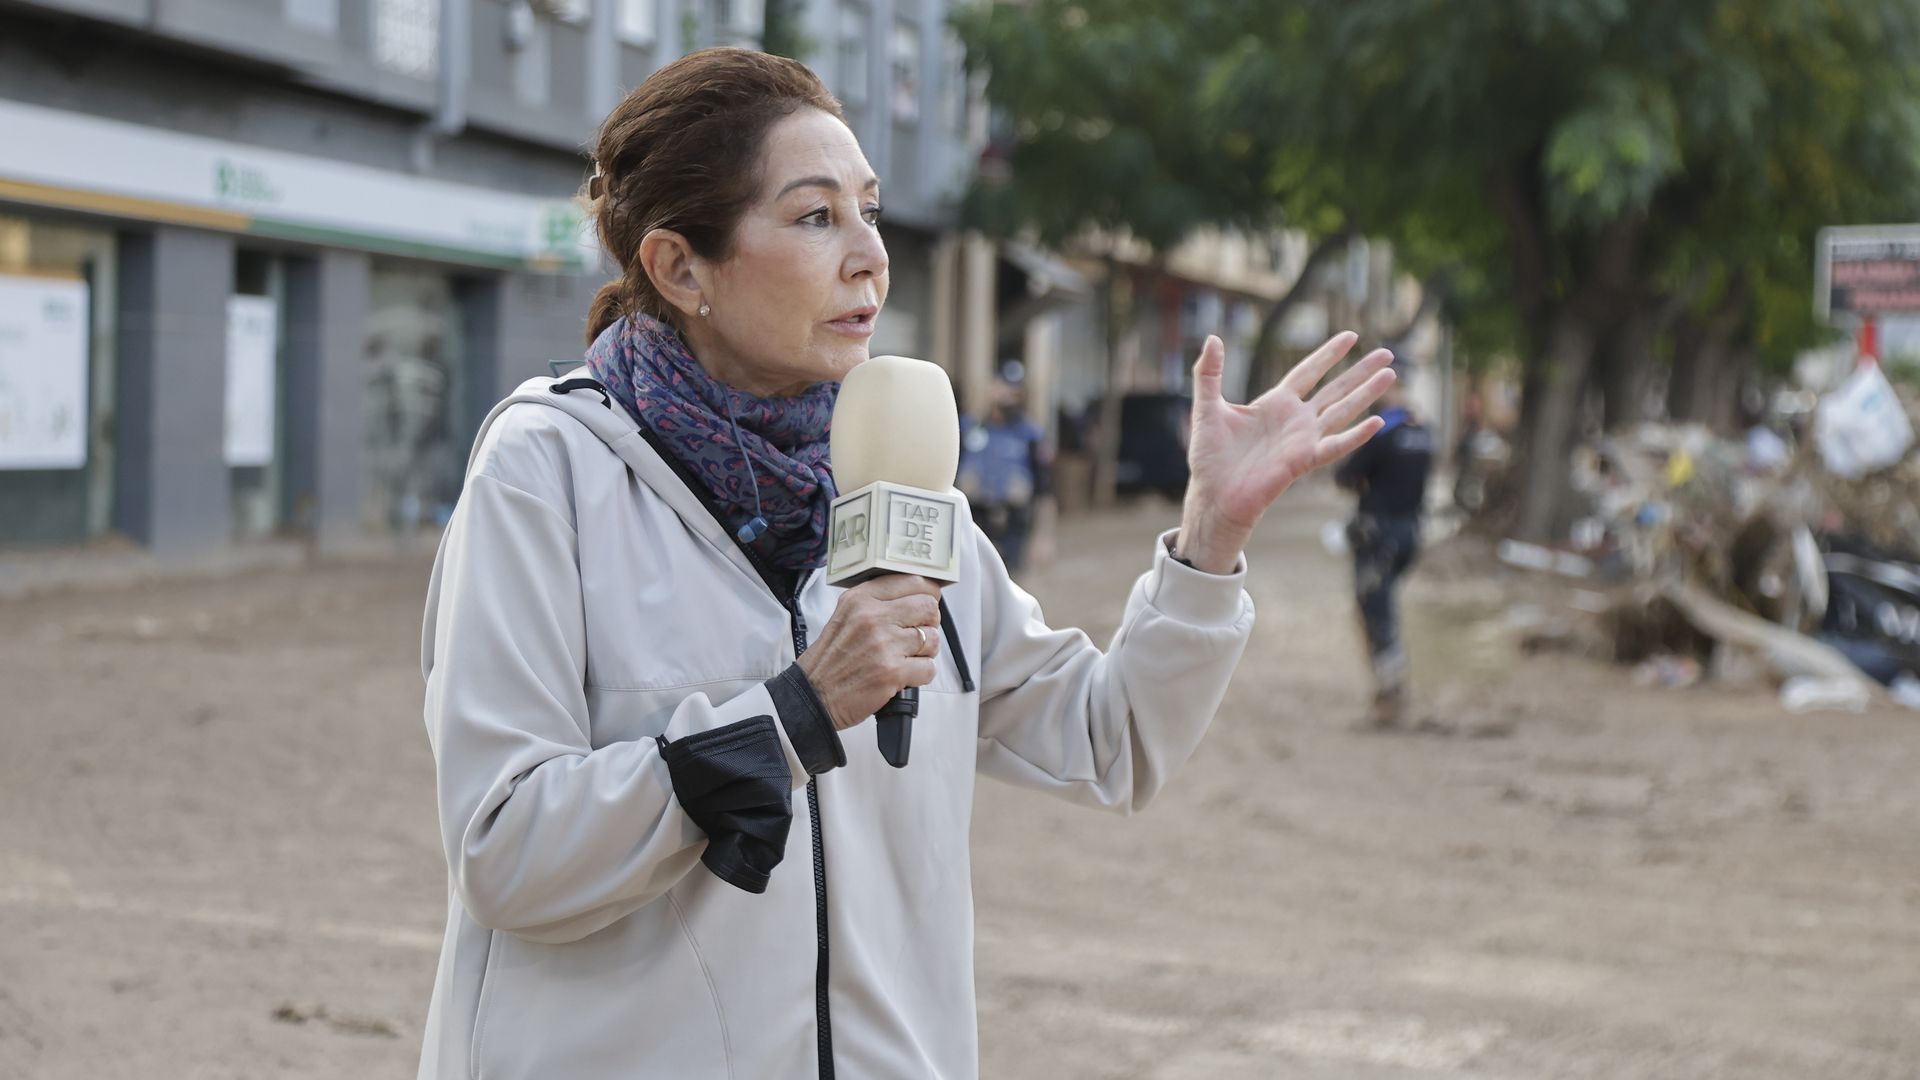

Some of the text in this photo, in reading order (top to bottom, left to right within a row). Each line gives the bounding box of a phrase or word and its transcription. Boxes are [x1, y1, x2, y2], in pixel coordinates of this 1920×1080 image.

[900, 502, 939, 524] TAR
[834, 513, 867, 552] AR
[905, 521, 934, 542] DE
[902, 541, 932, 560] AR
